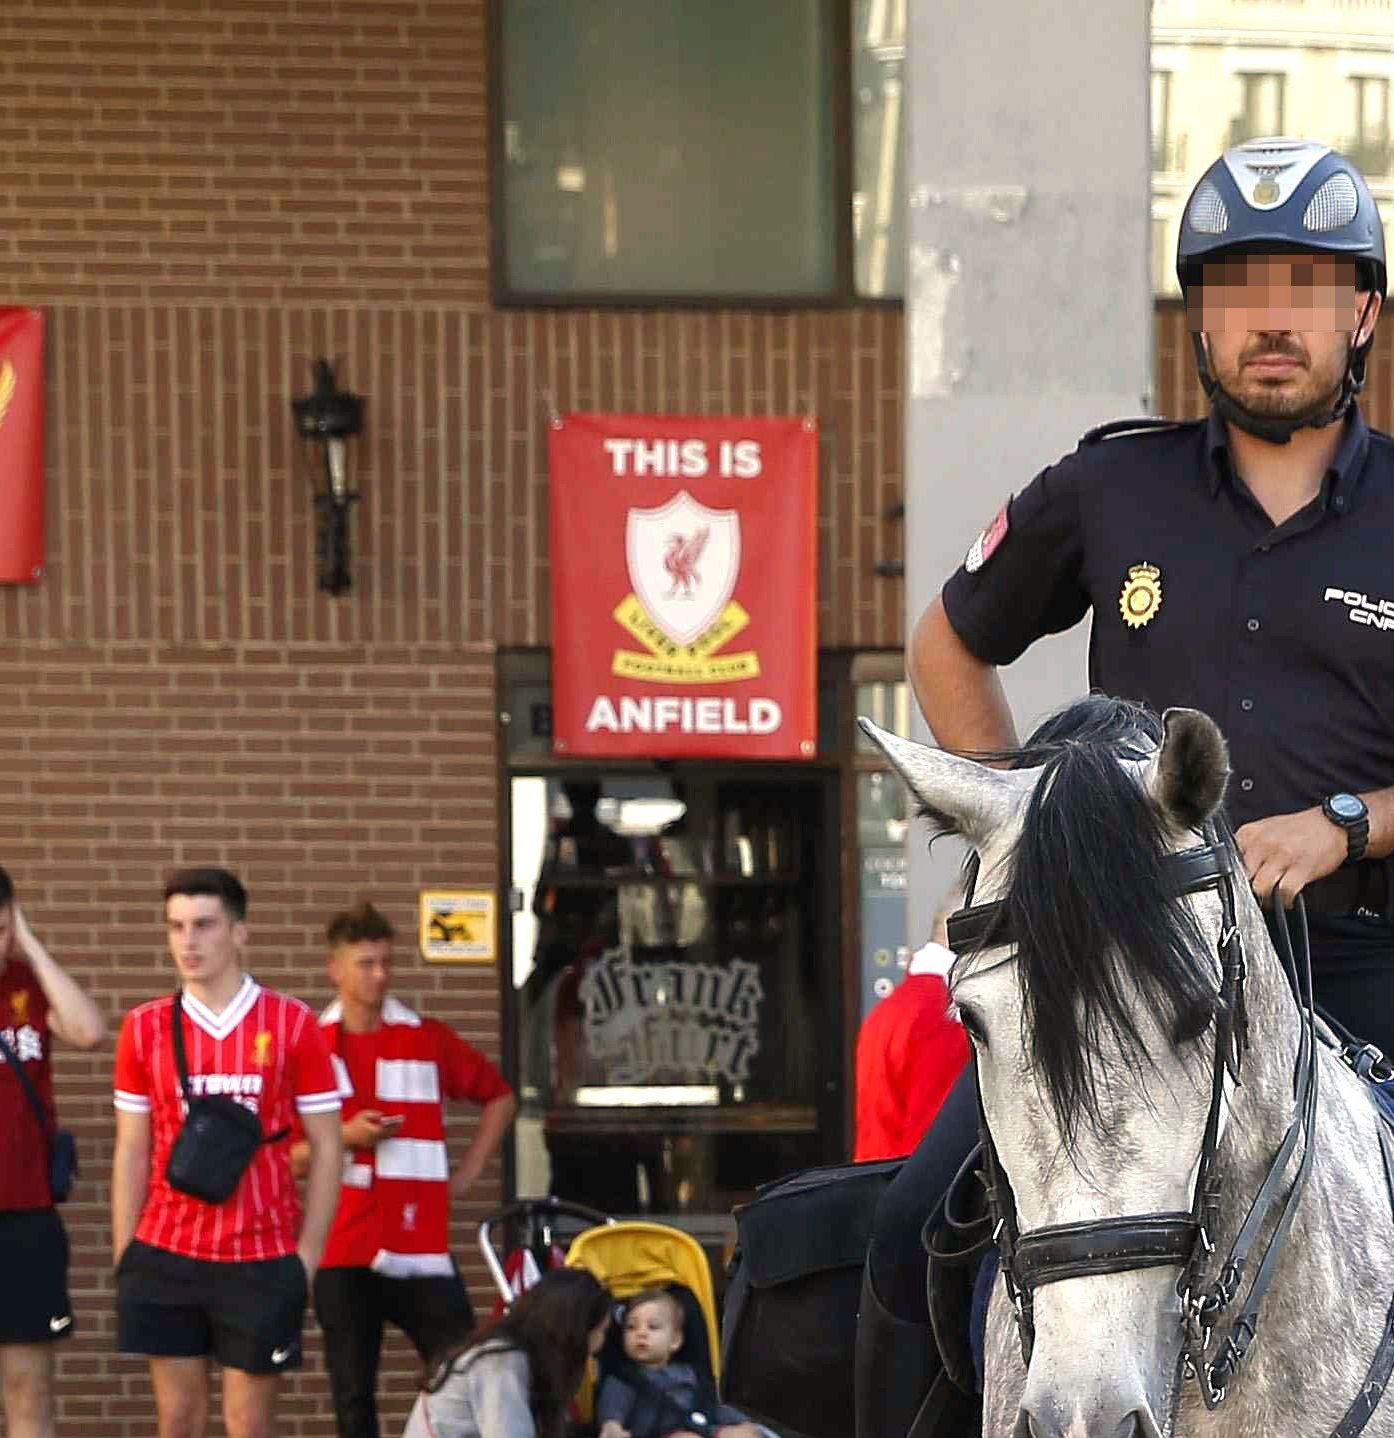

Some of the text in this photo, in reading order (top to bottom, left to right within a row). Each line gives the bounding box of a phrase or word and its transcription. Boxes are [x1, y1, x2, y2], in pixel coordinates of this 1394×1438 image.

[604, 438, 763, 479] THIS IS
[586, 696, 782, 734] ANFIELD
